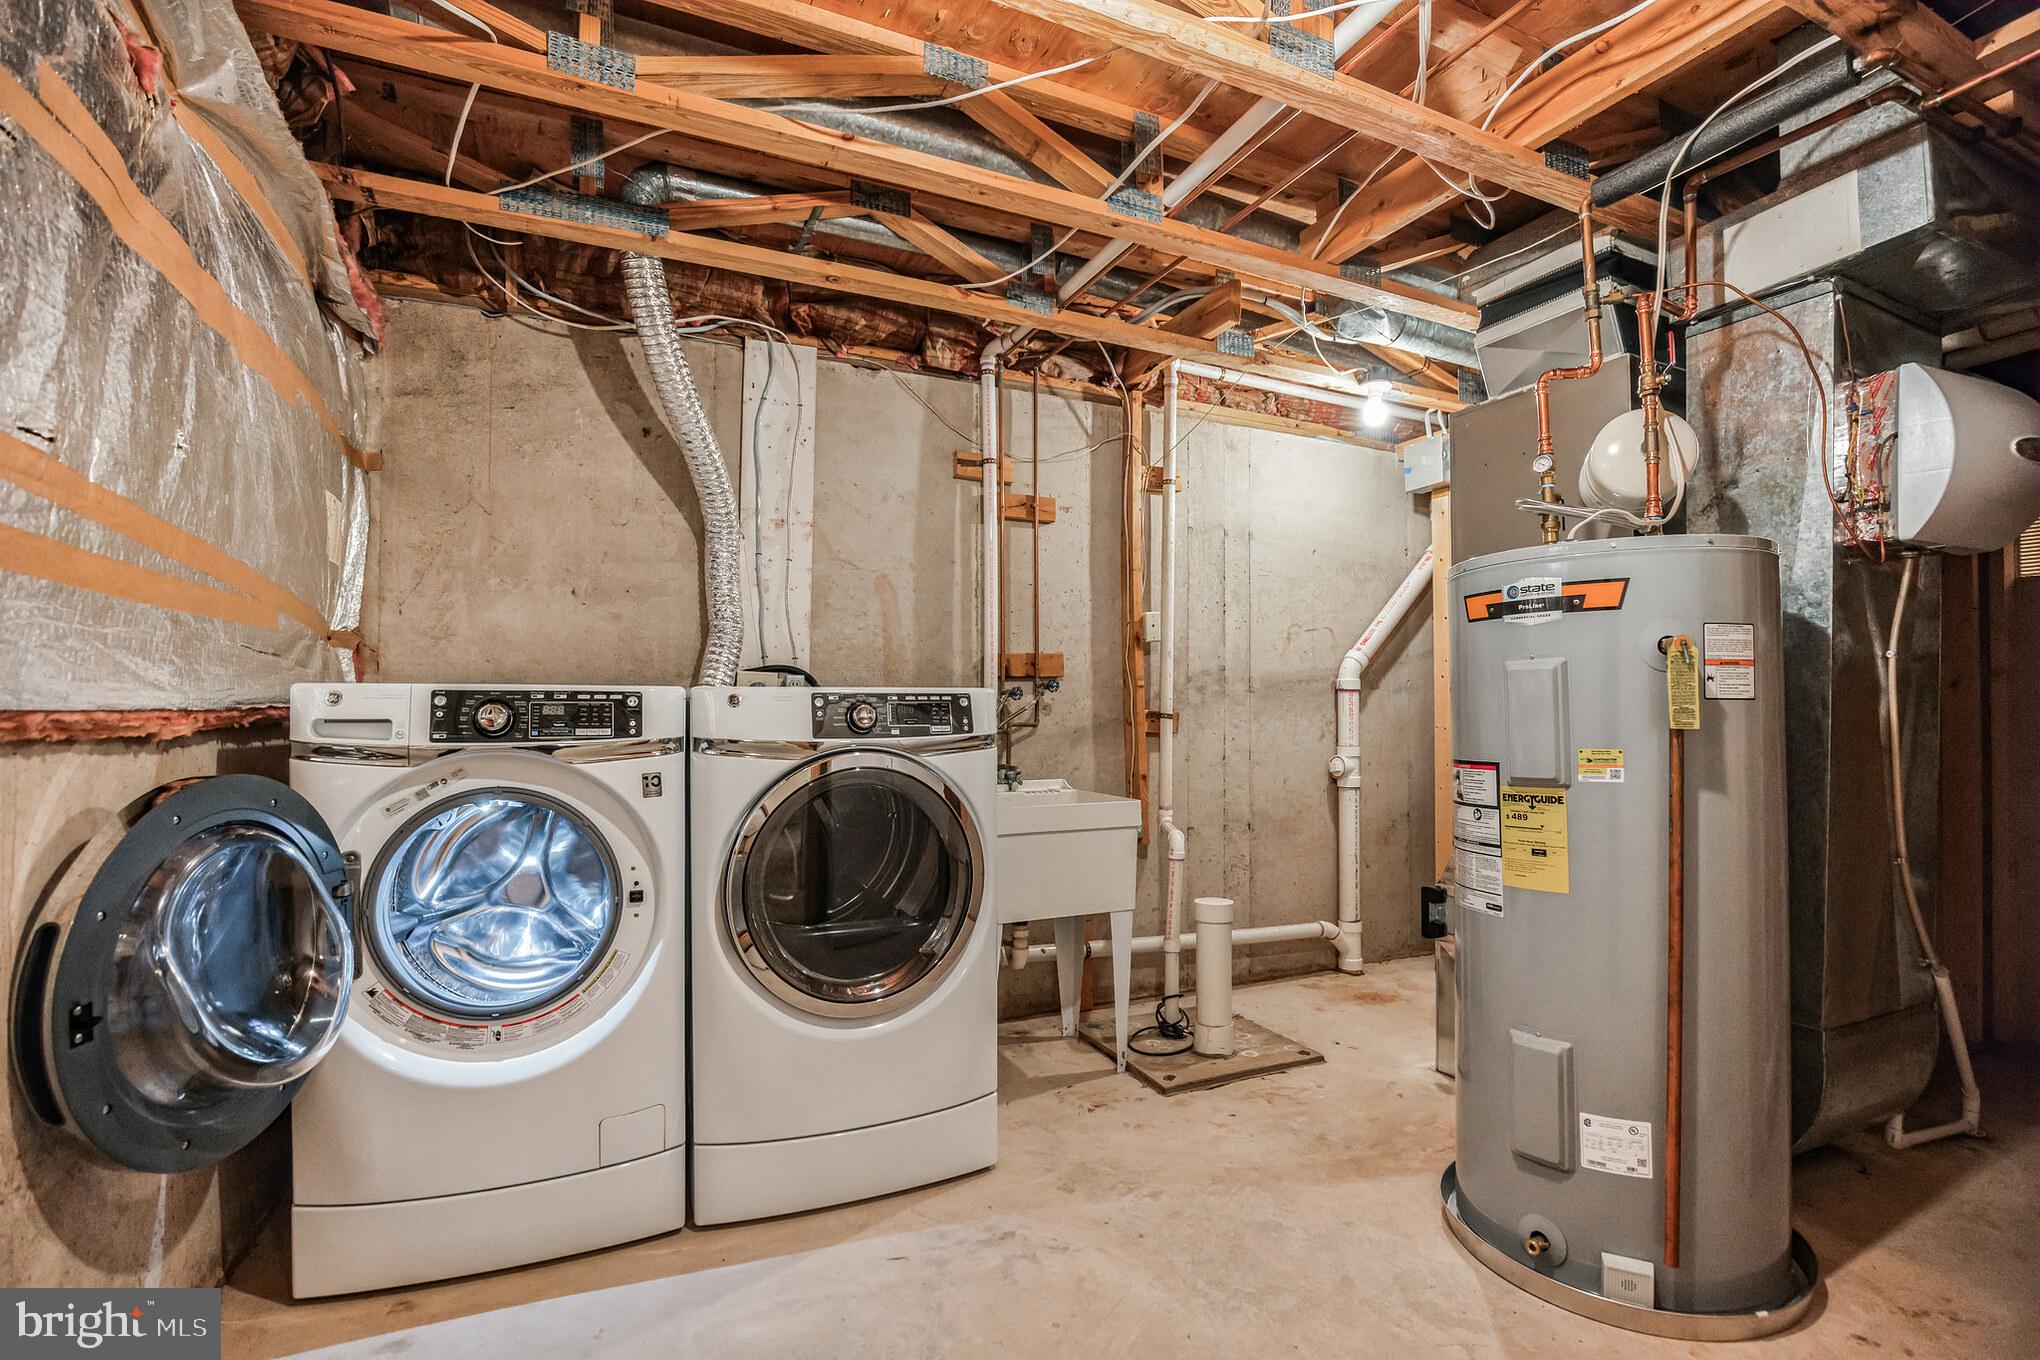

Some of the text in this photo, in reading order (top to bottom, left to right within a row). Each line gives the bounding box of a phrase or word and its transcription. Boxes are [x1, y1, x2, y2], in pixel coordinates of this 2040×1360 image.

[1520, 583, 1555, 594] state
[1503, 793, 1564, 806] ENERGYGUIDE
[1511, 812, 1528, 821] 489
